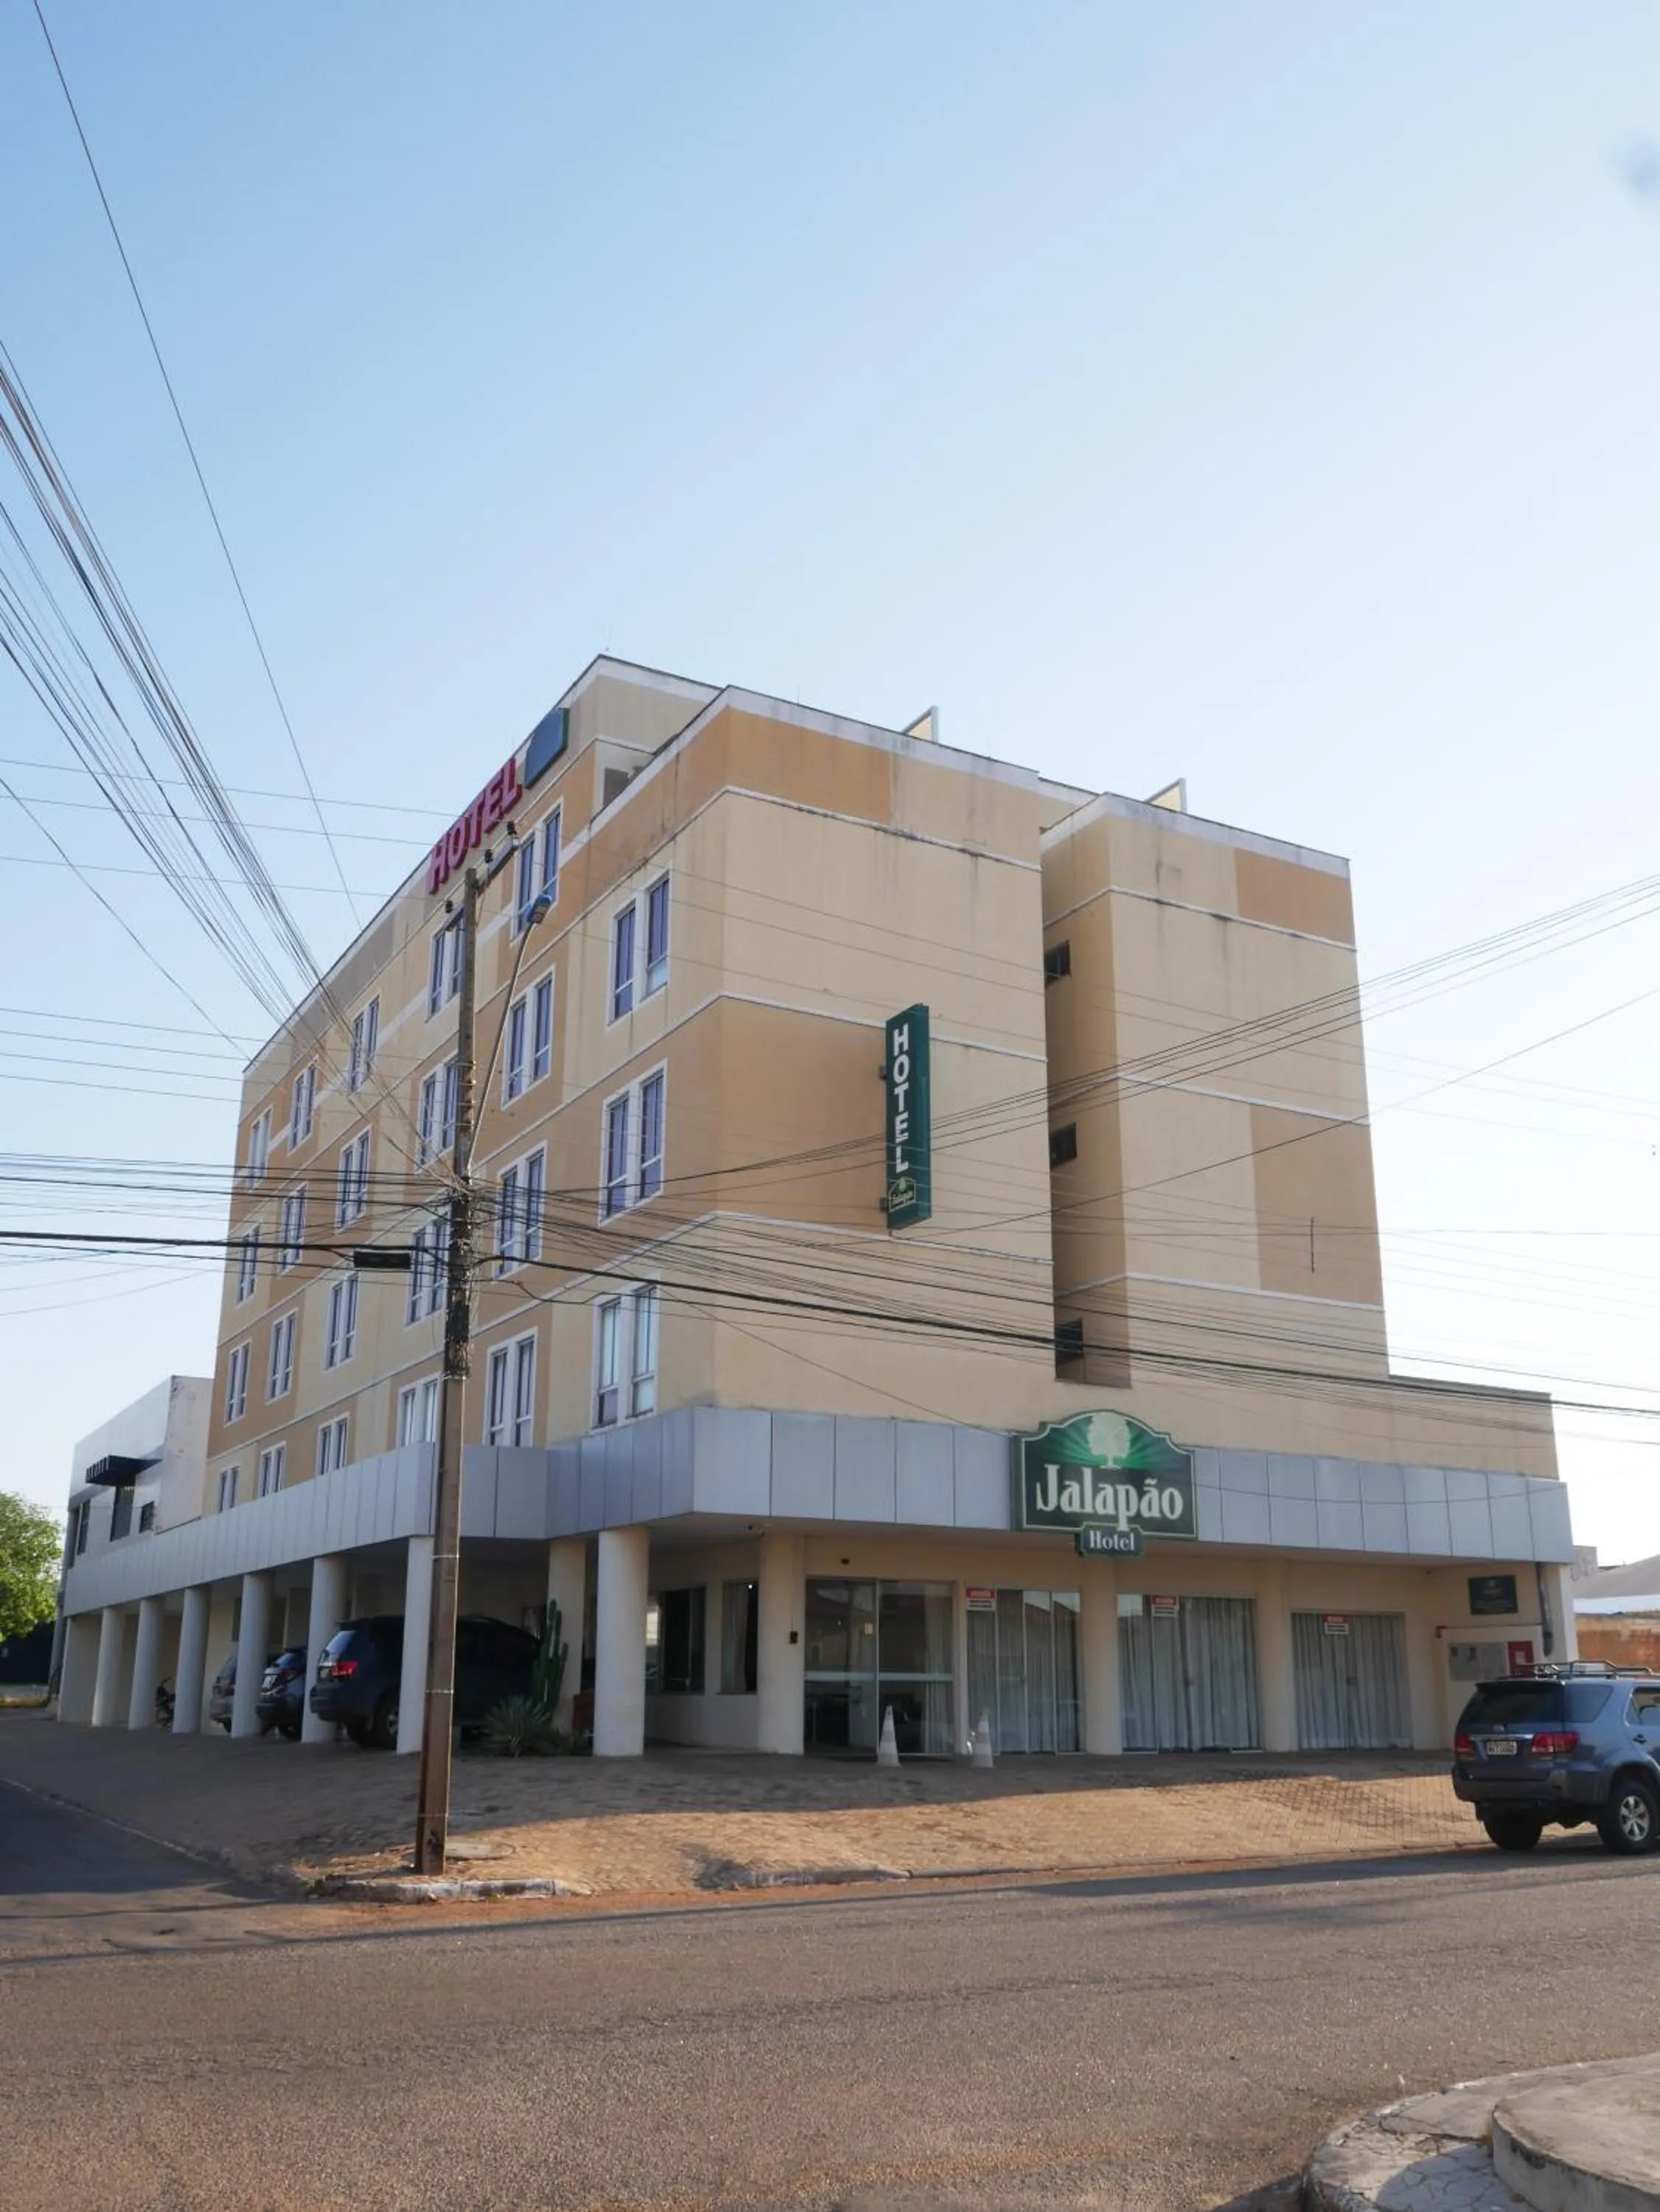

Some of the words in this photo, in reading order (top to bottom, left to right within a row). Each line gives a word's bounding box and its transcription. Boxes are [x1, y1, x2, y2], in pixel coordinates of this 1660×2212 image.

[429, 755, 522, 894] HOTEL
[893, 1023, 910, 1173] HOTEL
[1036, 1464, 1184, 1531] Jalapão
[1089, 1530, 1135, 1551] Hotel
